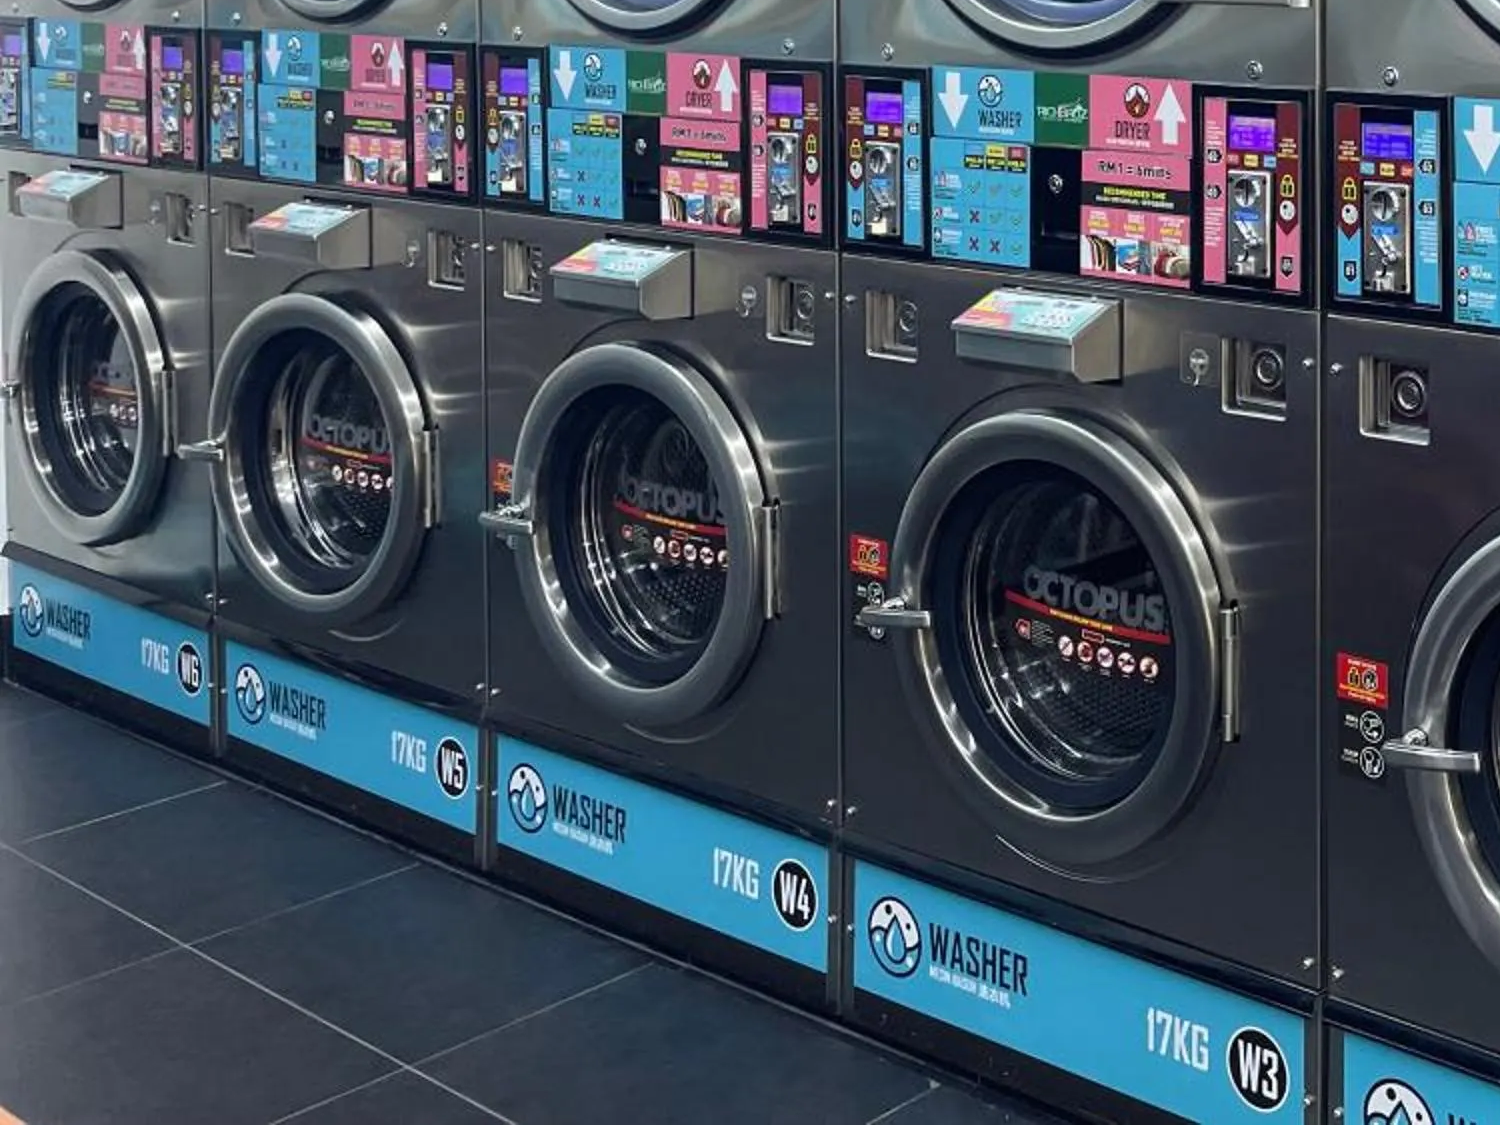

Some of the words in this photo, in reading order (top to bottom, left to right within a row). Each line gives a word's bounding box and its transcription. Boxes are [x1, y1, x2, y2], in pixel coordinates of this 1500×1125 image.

[978, 109, 1022, 129] WASHER
[1115, 120, 1151, 140] DRYER
[624, 477, 722, 524] OCTOPU
[46, 597, 91, 641] WASHER
[1024, 565, 1166, 631] OCTOPUS
[141, 637, 169, 674] 17KG
[181, 650, 200, 686] W6
[270, 680, 326, 730] WASHER
[391, 731, 427, 773] 17KG
[440, 749, 464, 790] W5
[553, 784, 627, 843] WASHER
[713, 846, 760, 900] 17KG
[780, 869, 811, 920] W4
[929, 921, 1029, 997] WASHER
[1146, 1007, 1209, 1073] 17KG
[1237, 1038, 1279, 1098] W3
